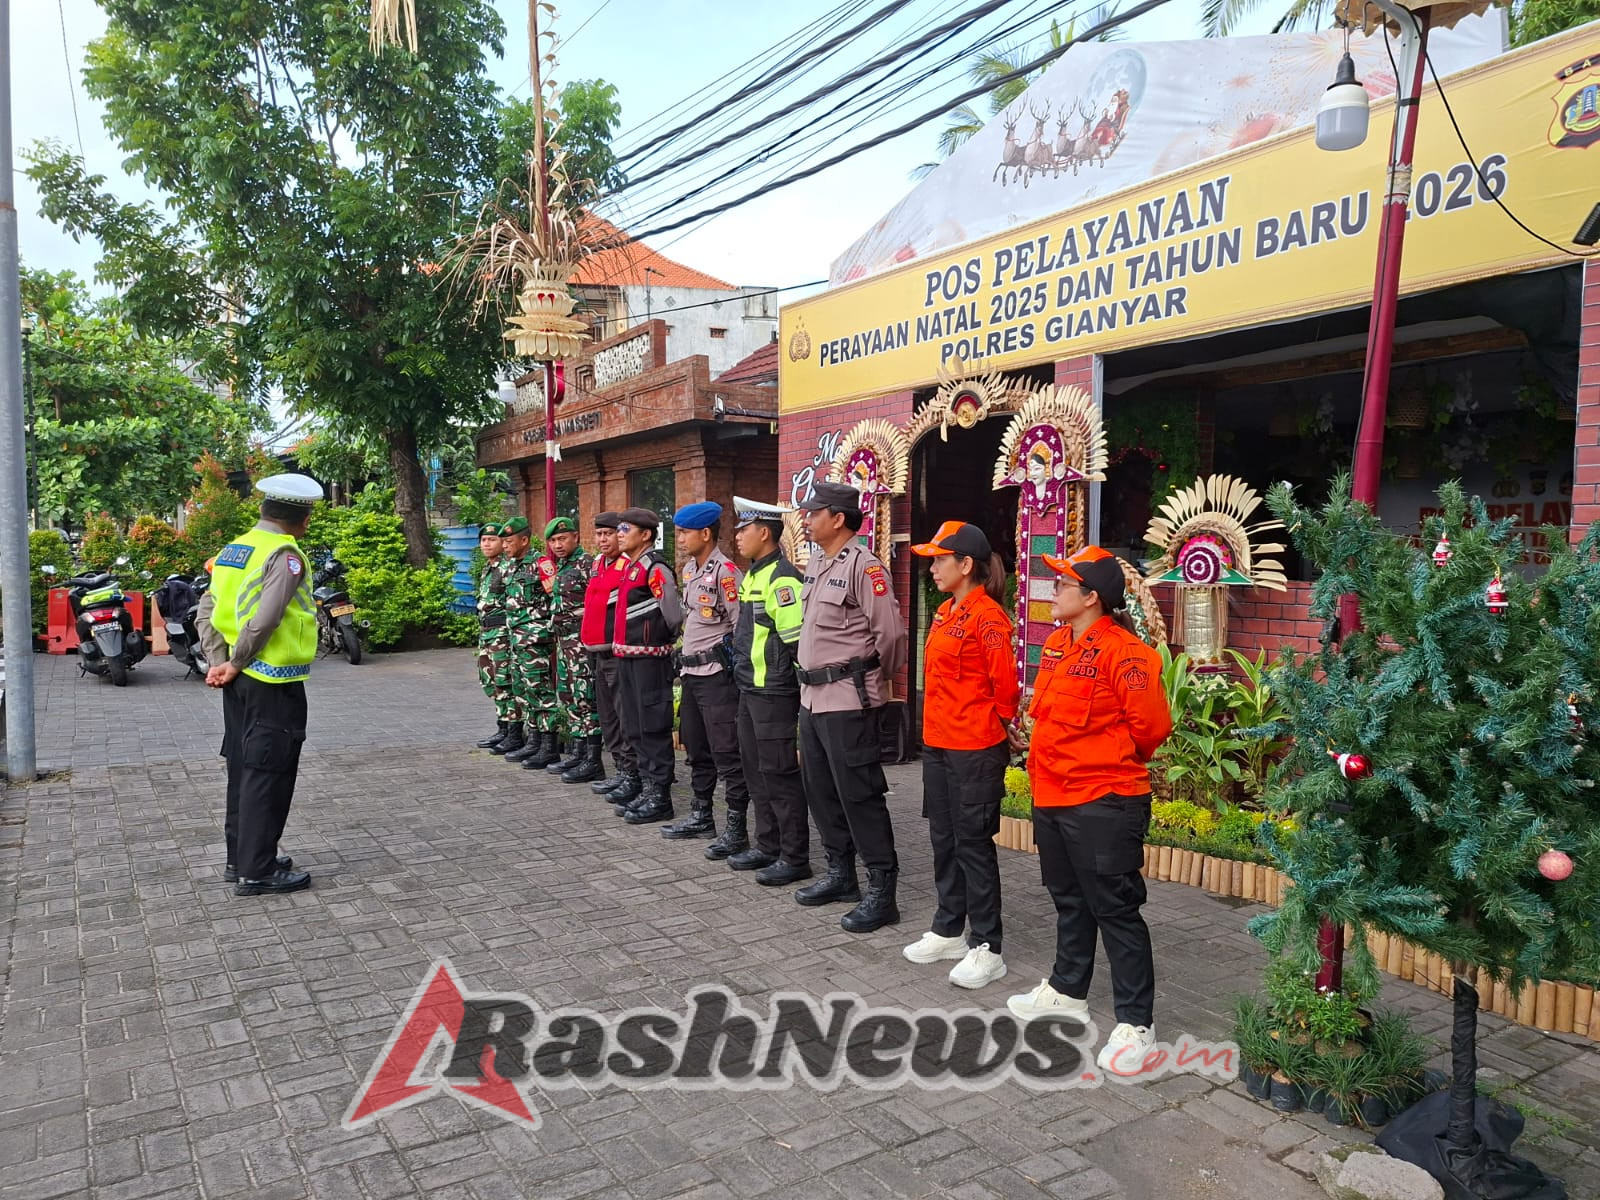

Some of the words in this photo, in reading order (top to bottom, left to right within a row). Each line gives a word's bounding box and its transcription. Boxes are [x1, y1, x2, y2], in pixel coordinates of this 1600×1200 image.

[820, 320, 909, 368] PERAYAAN
[916, 301, 982, 344] NATAL
[990, 282, 1047, 325] 2025
[1057, 263, 1114, 307] DAN
[1126, 227, 1242, 290] TAHUN
[1254, 191, 1370, 259] BARU
[1404, 154, 1507, 221] 026
[925, 257, 981, 307] POS
[992, 176, 1231, 287] PELAYANAN
[941, 321, 1035, 368] POLRES
[1045, 286, 1187, 343] GIANYAR
[698, 584, 718, 595] POLRI
[827, 578, 847, 589] POLRI
[1068, 664, 1095, 677] BPBD
